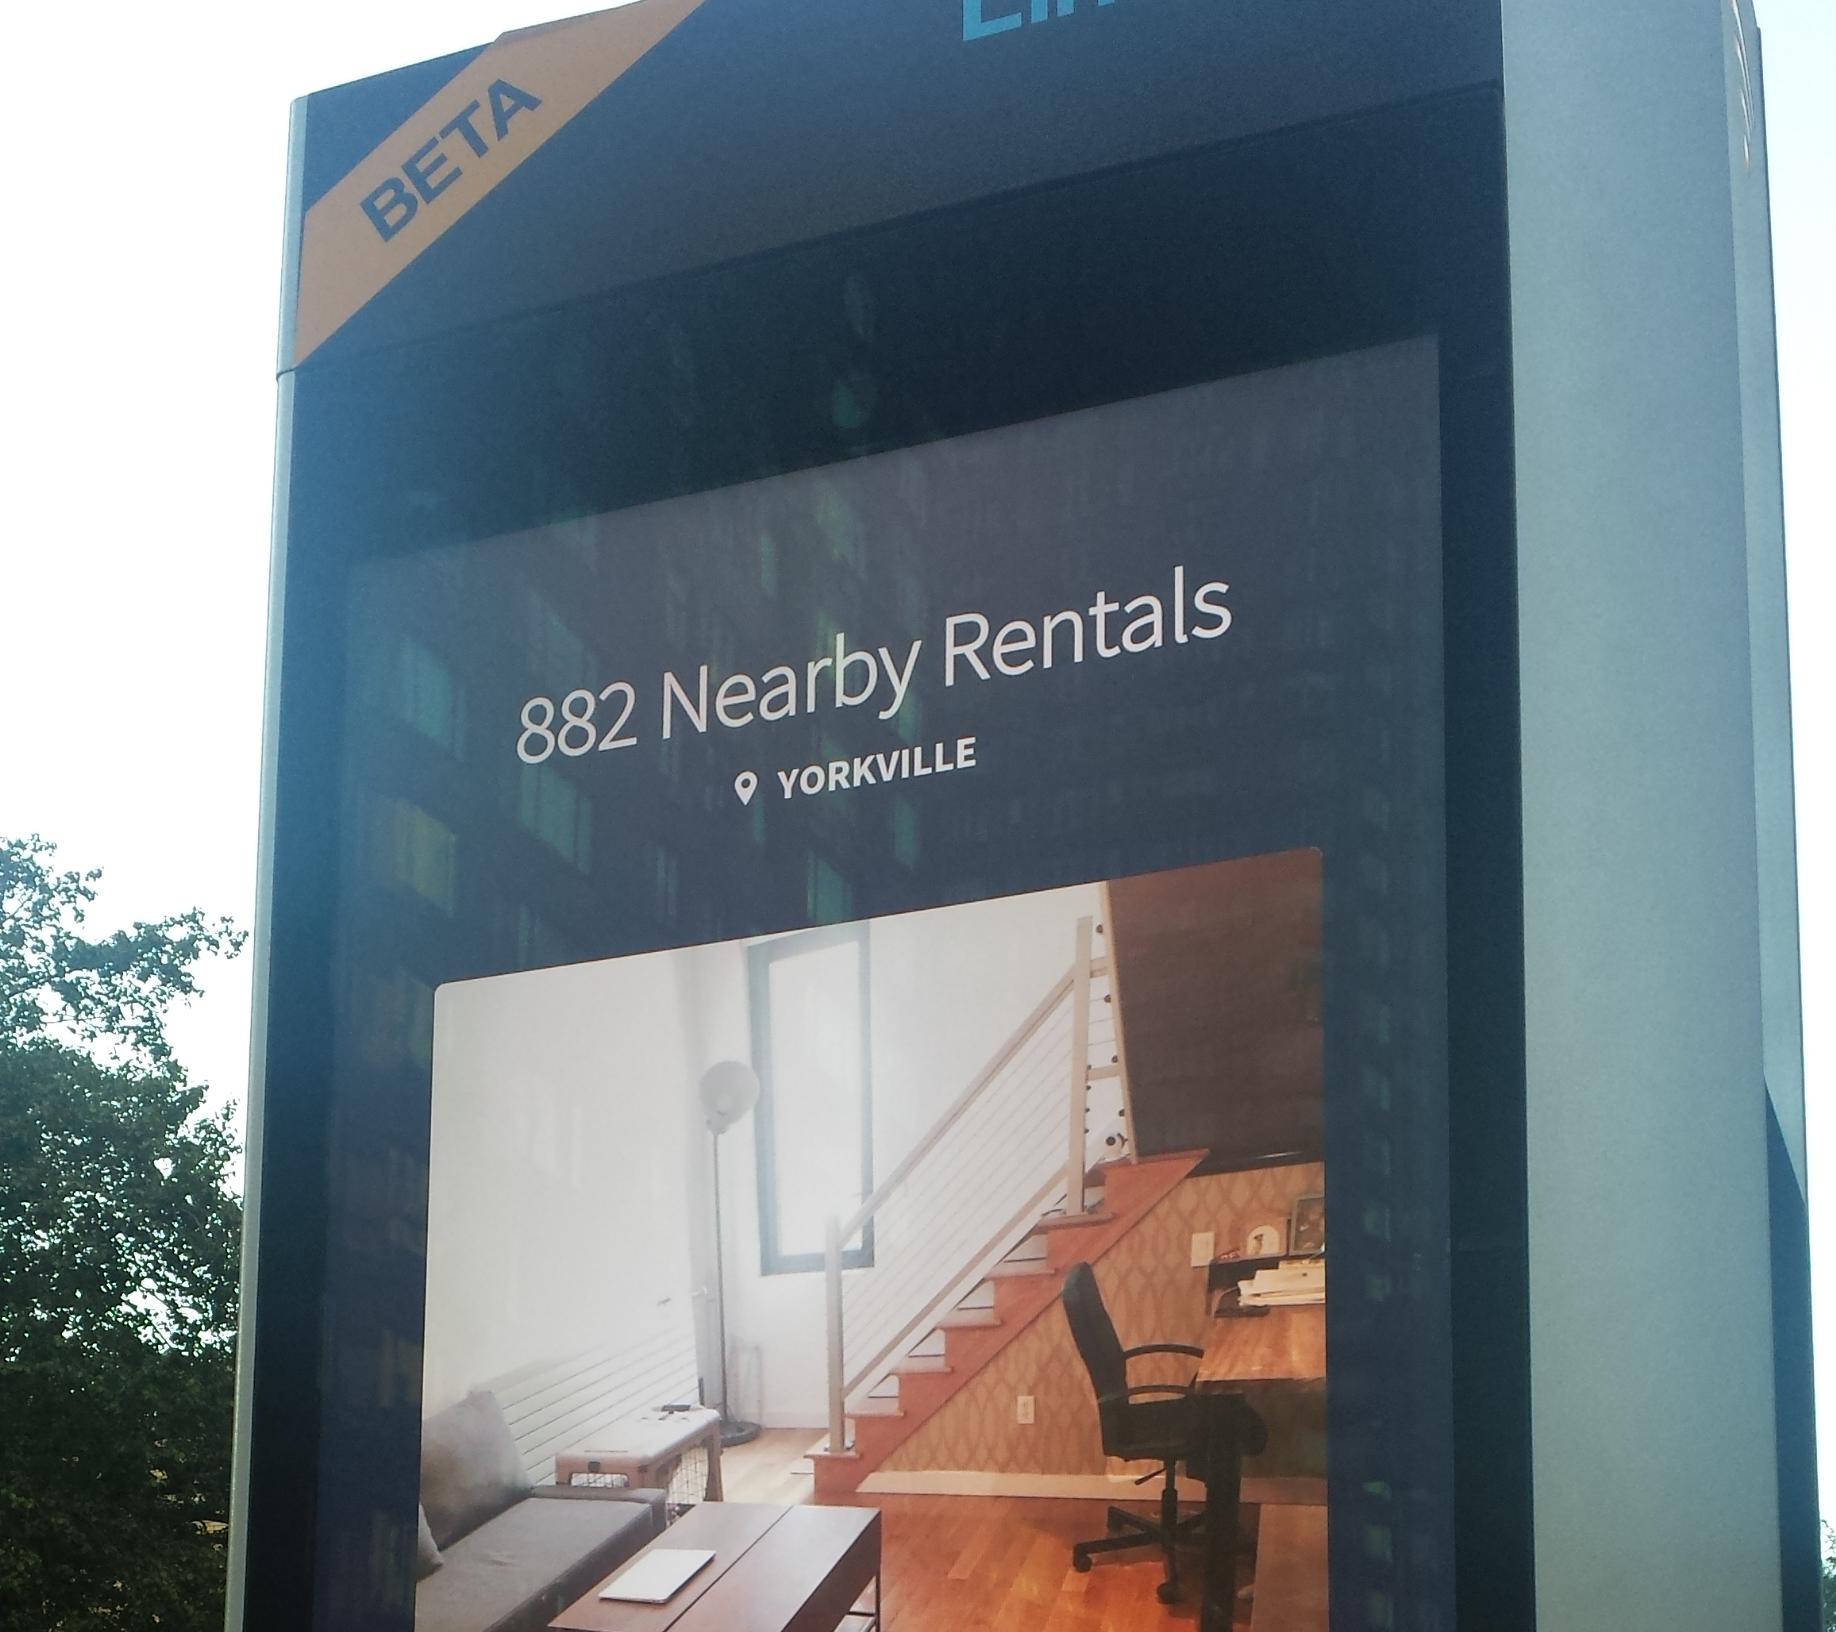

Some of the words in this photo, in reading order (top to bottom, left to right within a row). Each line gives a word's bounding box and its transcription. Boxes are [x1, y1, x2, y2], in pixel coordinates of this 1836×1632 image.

[360, 79, 542, 242] BETA
[516, 682, 637, 764] 882
[662, 633, 922, 739] Nearby
[945, 566, 1232, 687] Rentals
[778, 737, 977, 799] YORKVILLE
